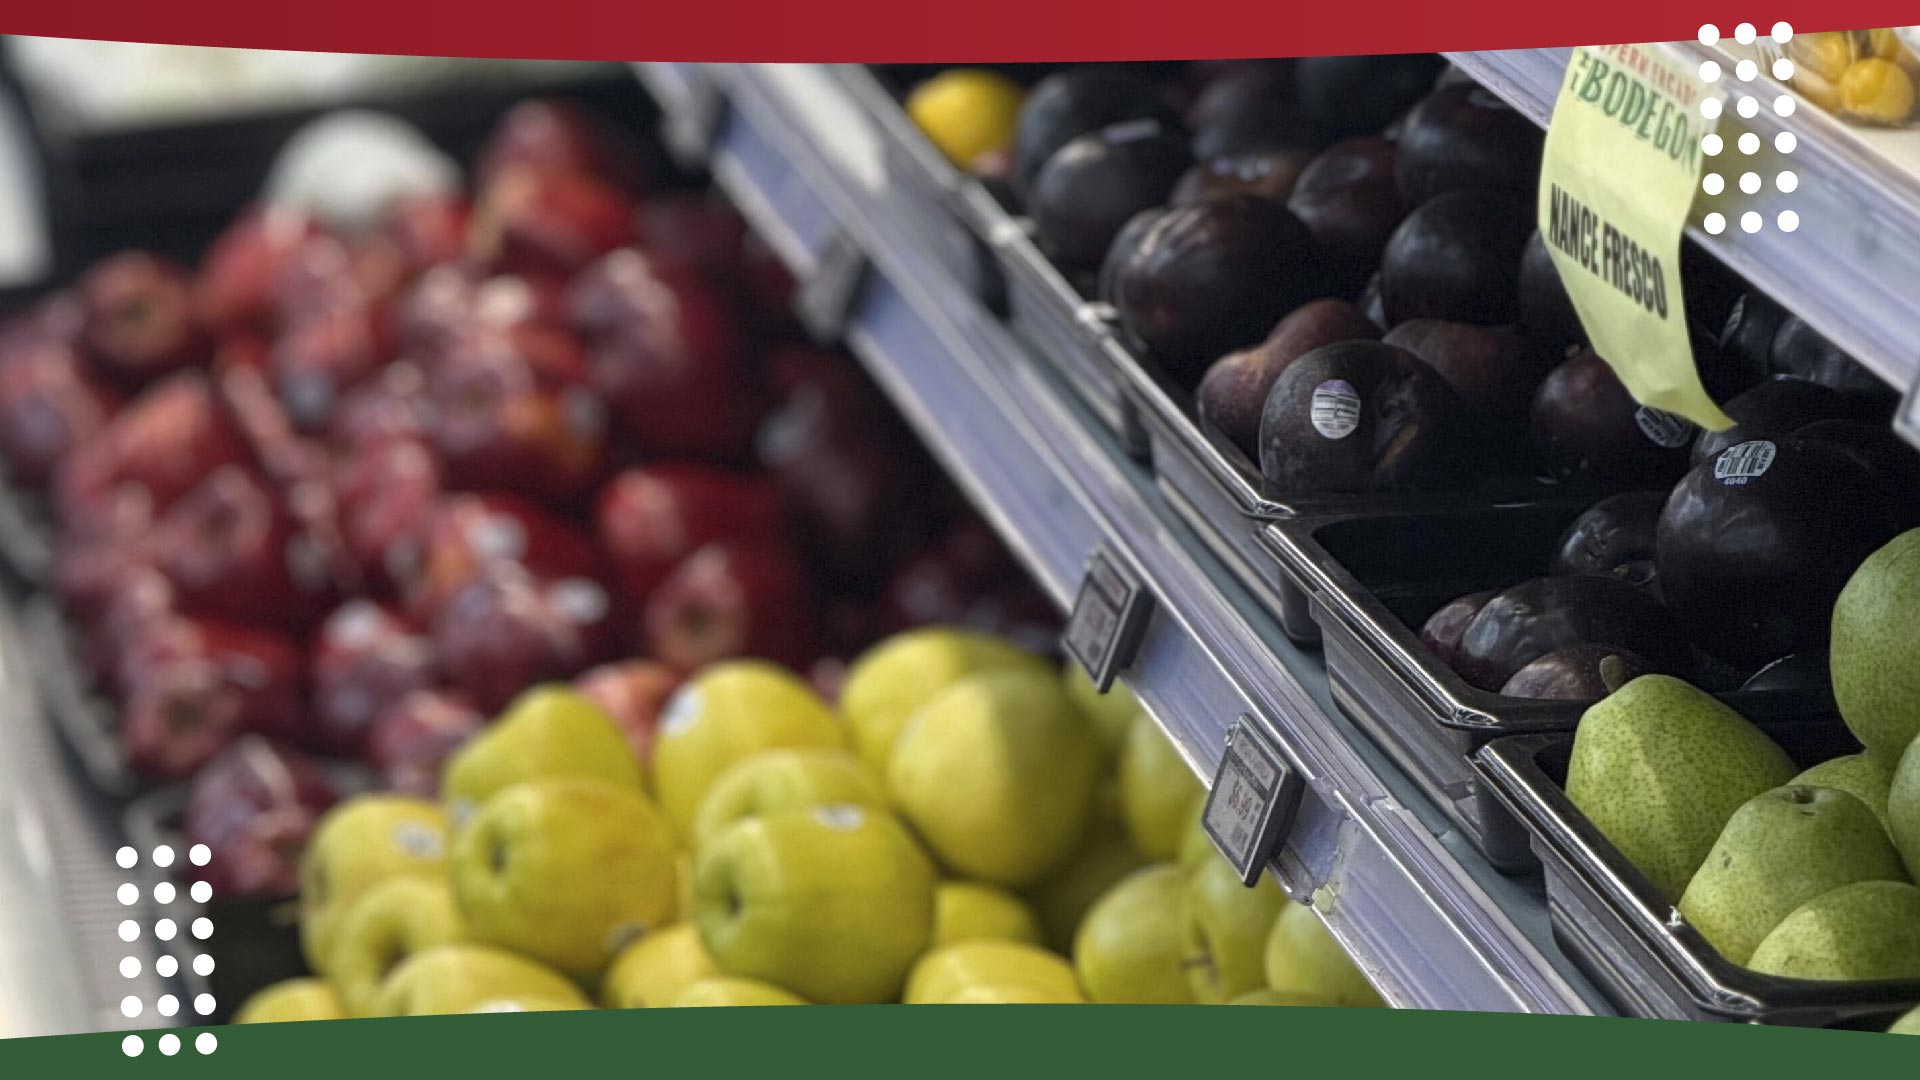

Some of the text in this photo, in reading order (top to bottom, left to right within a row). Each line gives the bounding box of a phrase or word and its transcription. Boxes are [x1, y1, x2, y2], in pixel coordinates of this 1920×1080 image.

[1549, 182, 1668, 320] NANCE FRESCO
[1723, 476, 1748, 486] 4040
